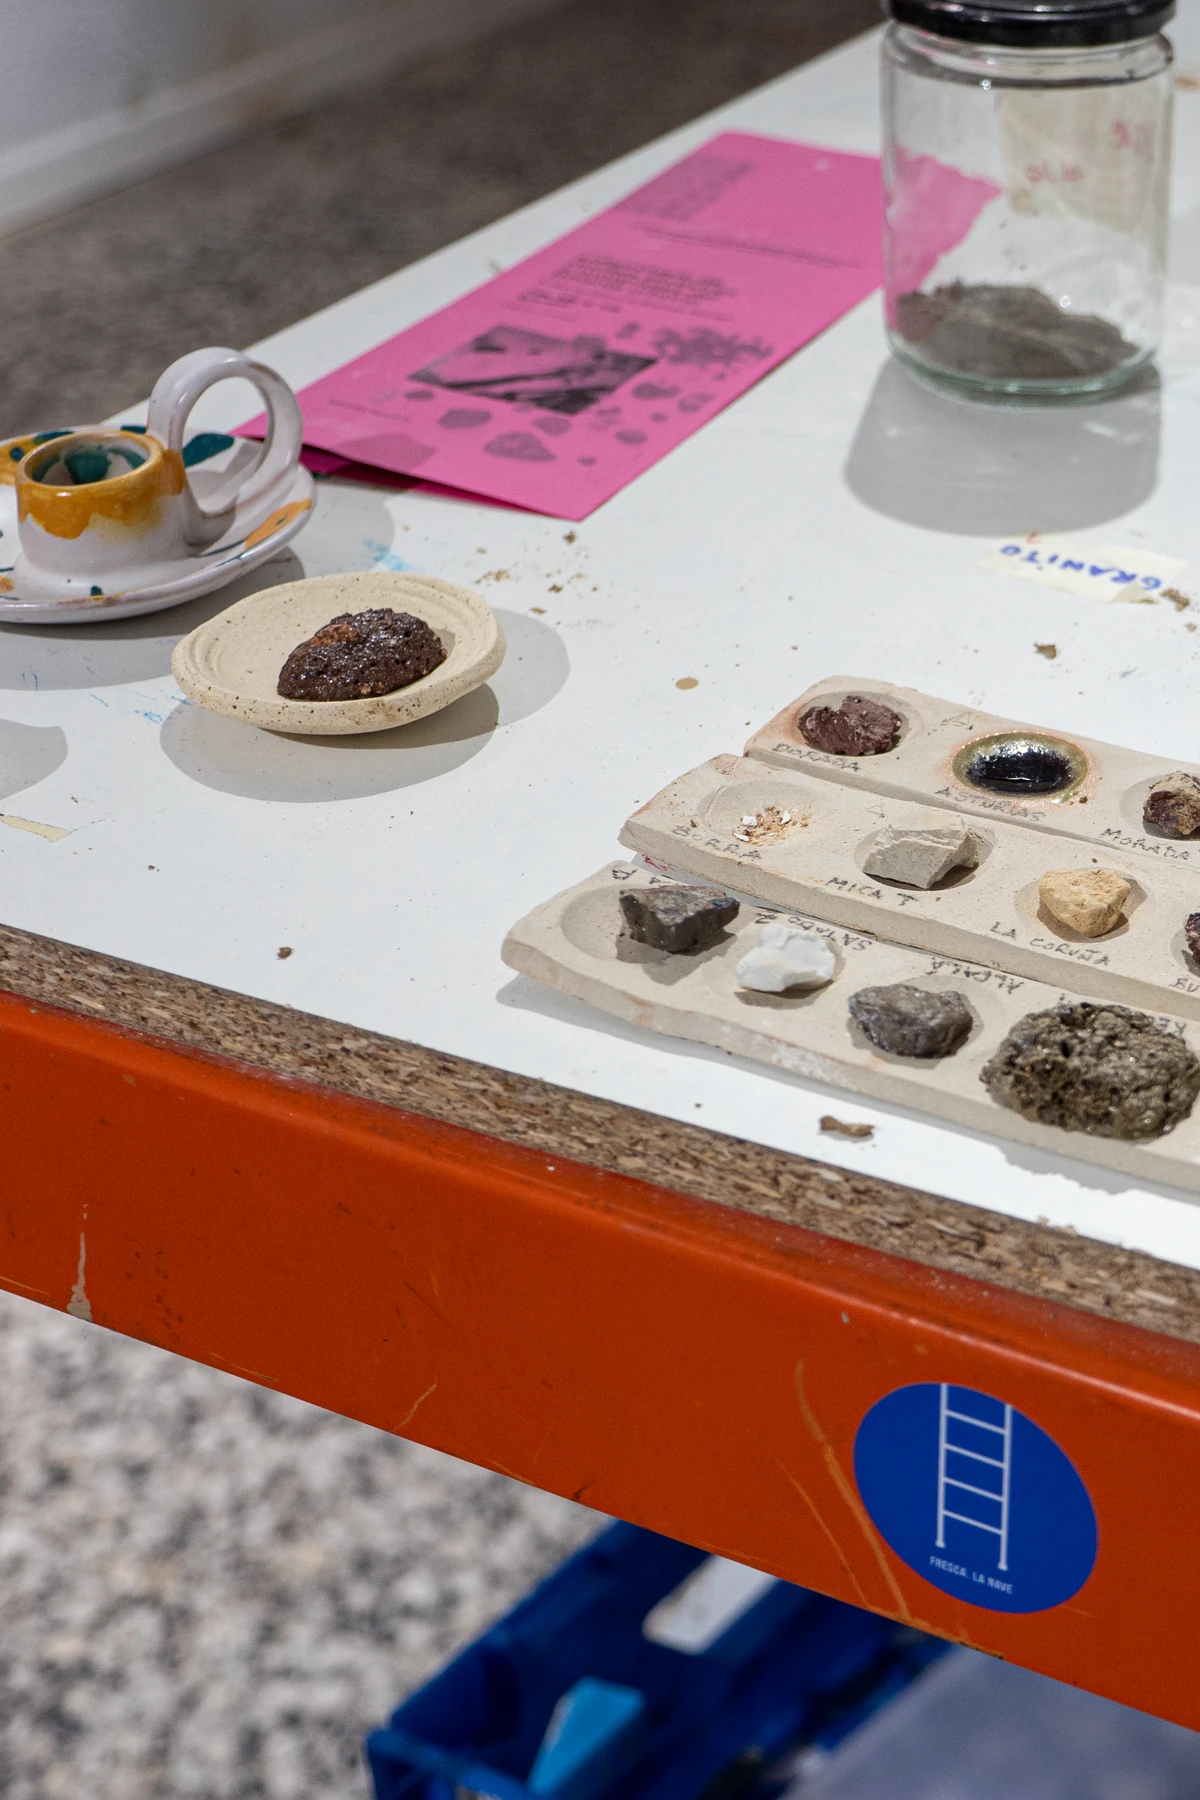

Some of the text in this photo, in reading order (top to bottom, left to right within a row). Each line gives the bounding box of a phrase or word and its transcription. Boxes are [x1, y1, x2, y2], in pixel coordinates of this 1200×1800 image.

[999, 544, 1163, 591] GRANITO
[990, 920, 1017, 939] LA
[972, 1571, 985, 1584] LA
[987, 1577, 1013, 1595] NAVE
